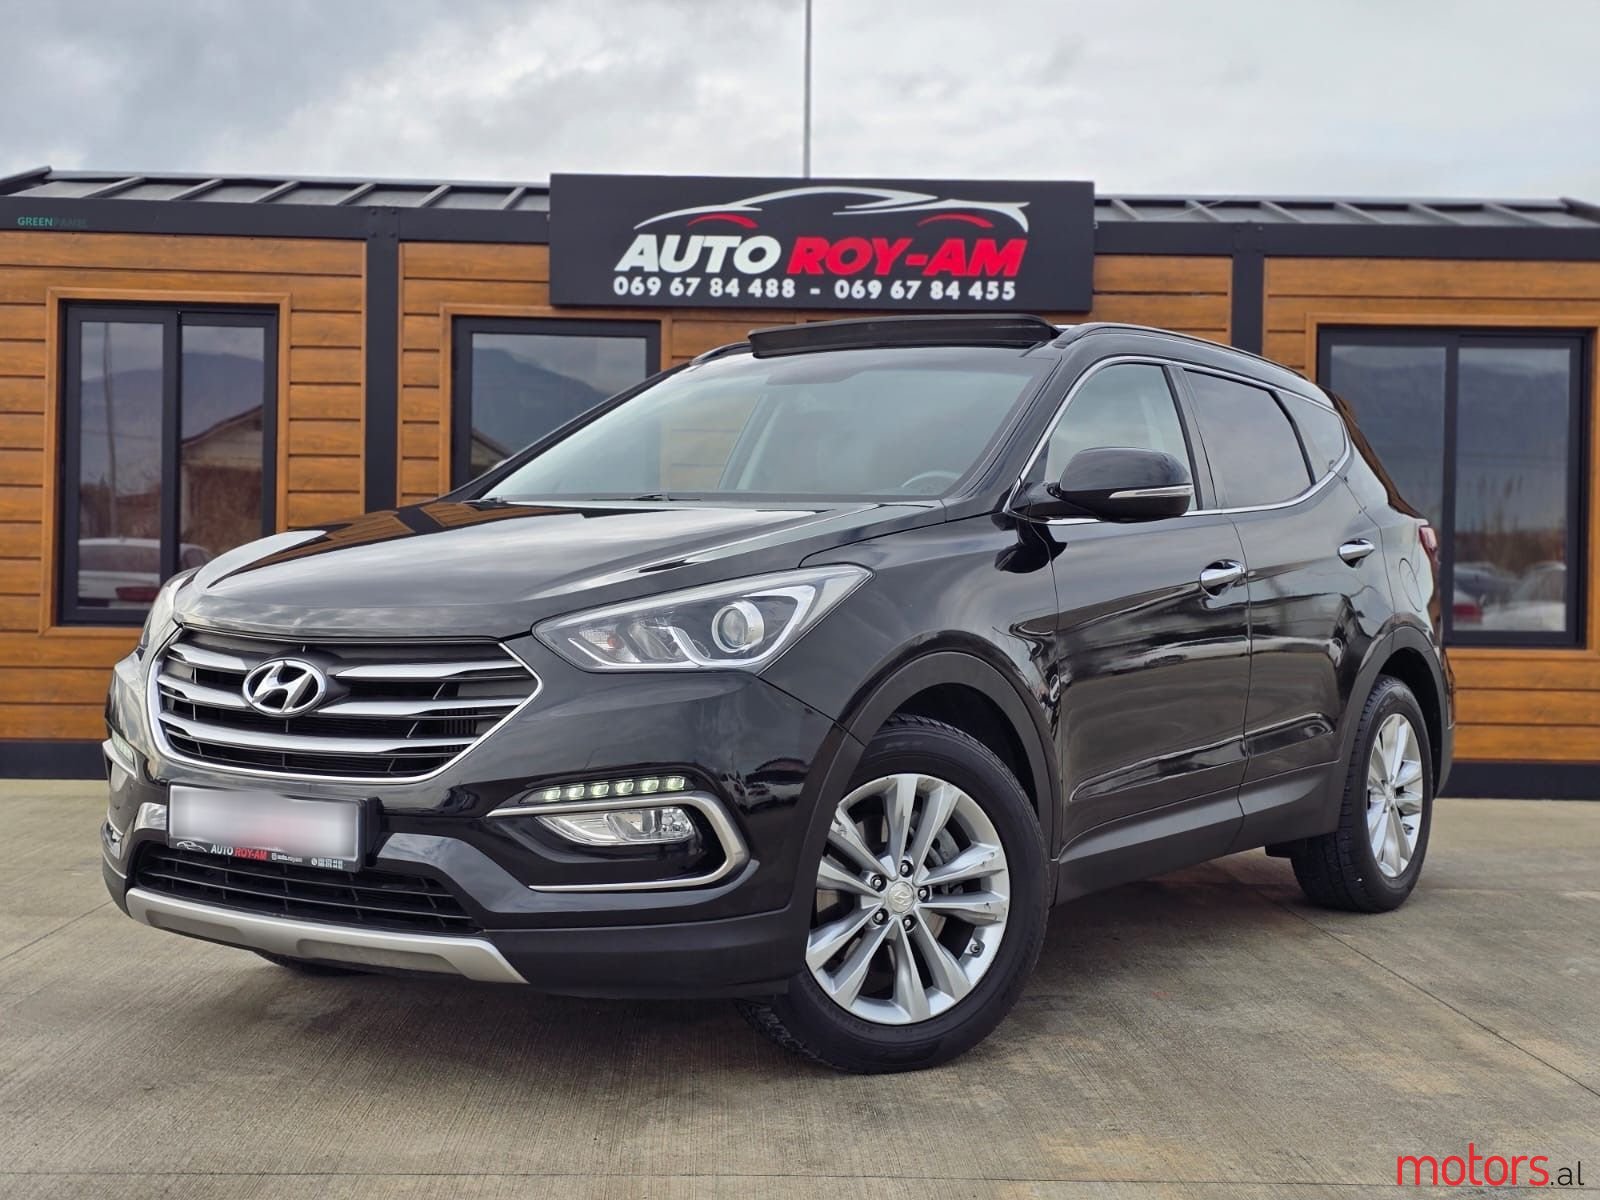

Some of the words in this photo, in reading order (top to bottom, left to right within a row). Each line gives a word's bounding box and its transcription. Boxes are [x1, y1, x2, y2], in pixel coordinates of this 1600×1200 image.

[613, 233, 782, 275] AUTO
[786, 236, 1028, 277] ROY-AM
[613, 275, 662, 296] 069
[669, 277, 702, 297] 67
[709, 277, 740, 298] 84
[747, 278, 796, 299] 488
[834, 279, 883, 300] 069
[890, 279, 922, 300] 67
[929, 280, 961, 300] 84
[968, 280, 1016, 301] 455
[210, 844, 234, 856] AUTO
[234, 847, 267, 860] ROY-AM
